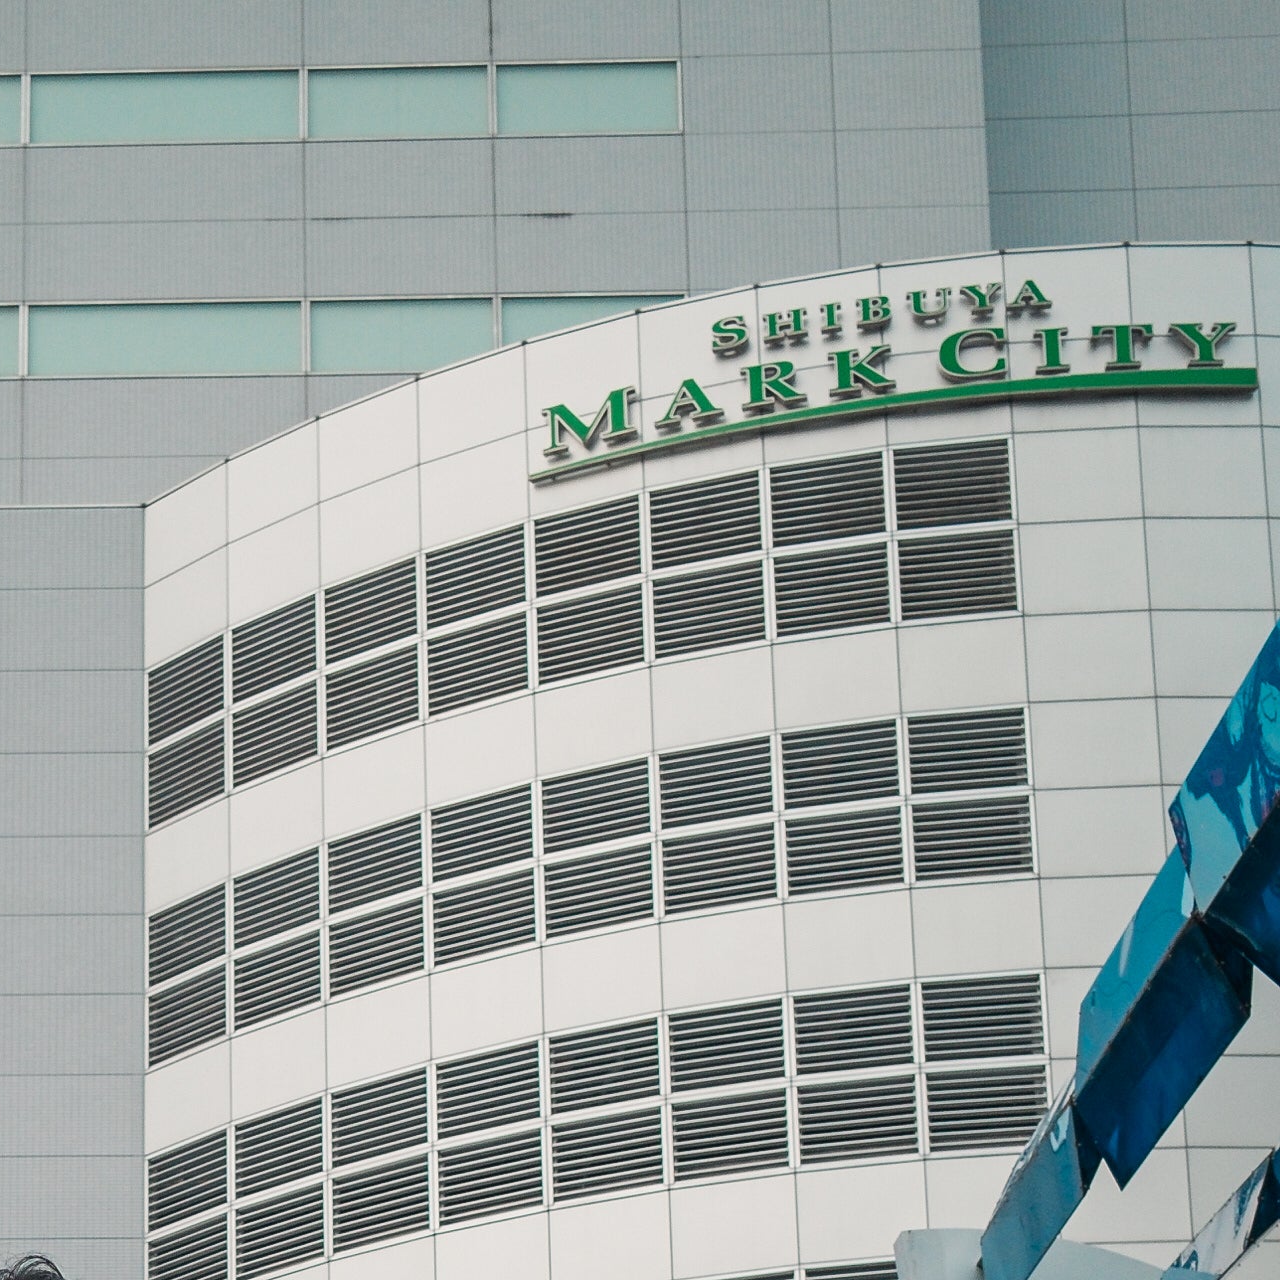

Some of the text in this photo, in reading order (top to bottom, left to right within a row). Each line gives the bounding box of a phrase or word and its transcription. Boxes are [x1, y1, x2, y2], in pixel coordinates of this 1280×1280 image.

[711, 279, 1053, 356] SHIBUYA
[542, 321, 1237, 457] MARK CITY
